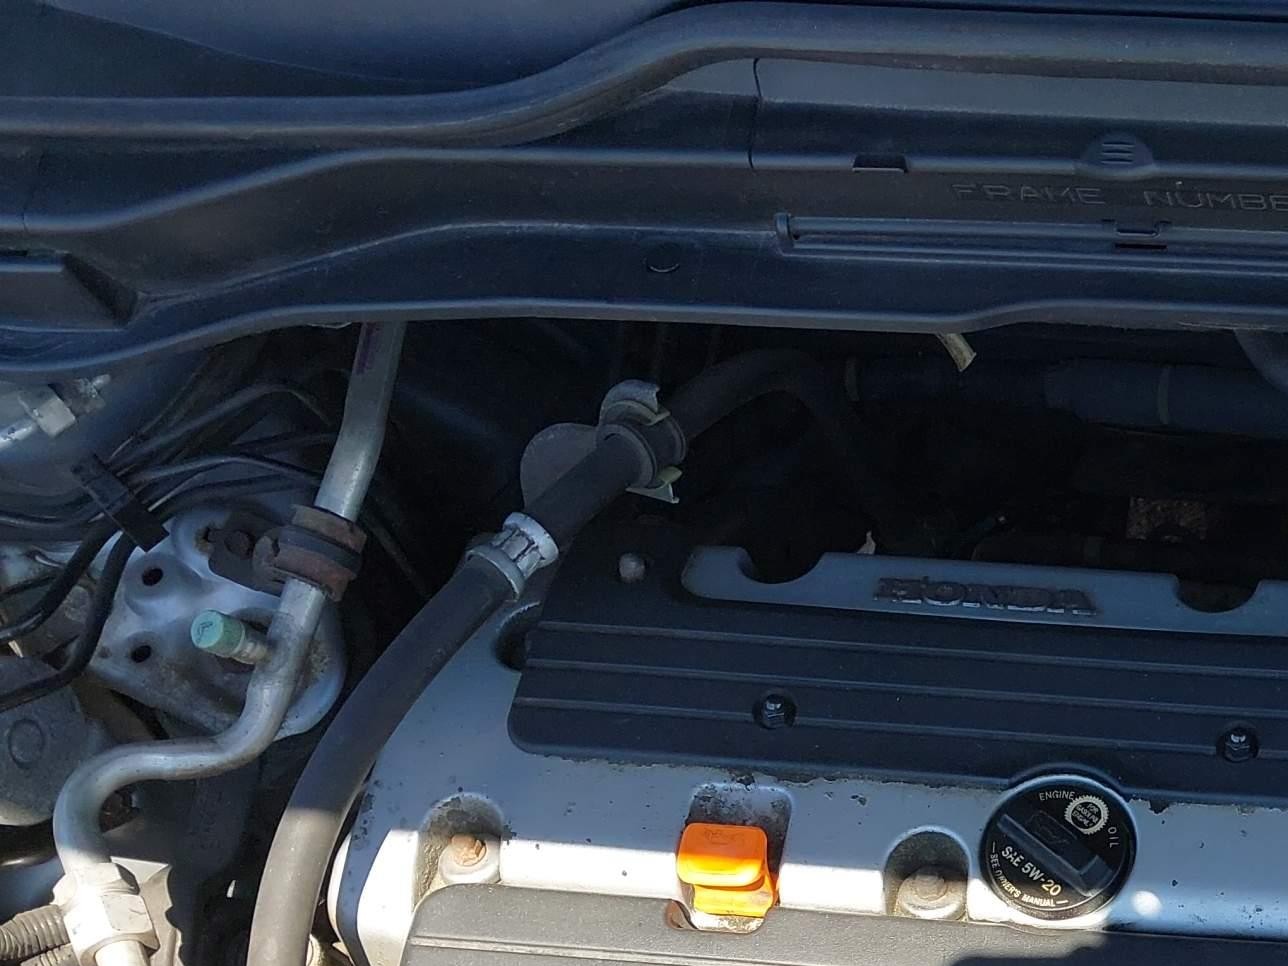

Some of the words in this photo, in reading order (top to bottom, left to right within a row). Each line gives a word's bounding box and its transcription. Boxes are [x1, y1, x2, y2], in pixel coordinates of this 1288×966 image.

[950, 182, 1104, 206] FRAME
[874, 577, 1097, 616] HONDA
[1039, 789, 1076, 801] ENGINE
[1107, 826, 1120, 848] OIL
[1001, 846, 1025, 867] SAE
[1021, 862, 1062, 896] 5W-20
[1021, 893, 1056, 907] MANUAL
